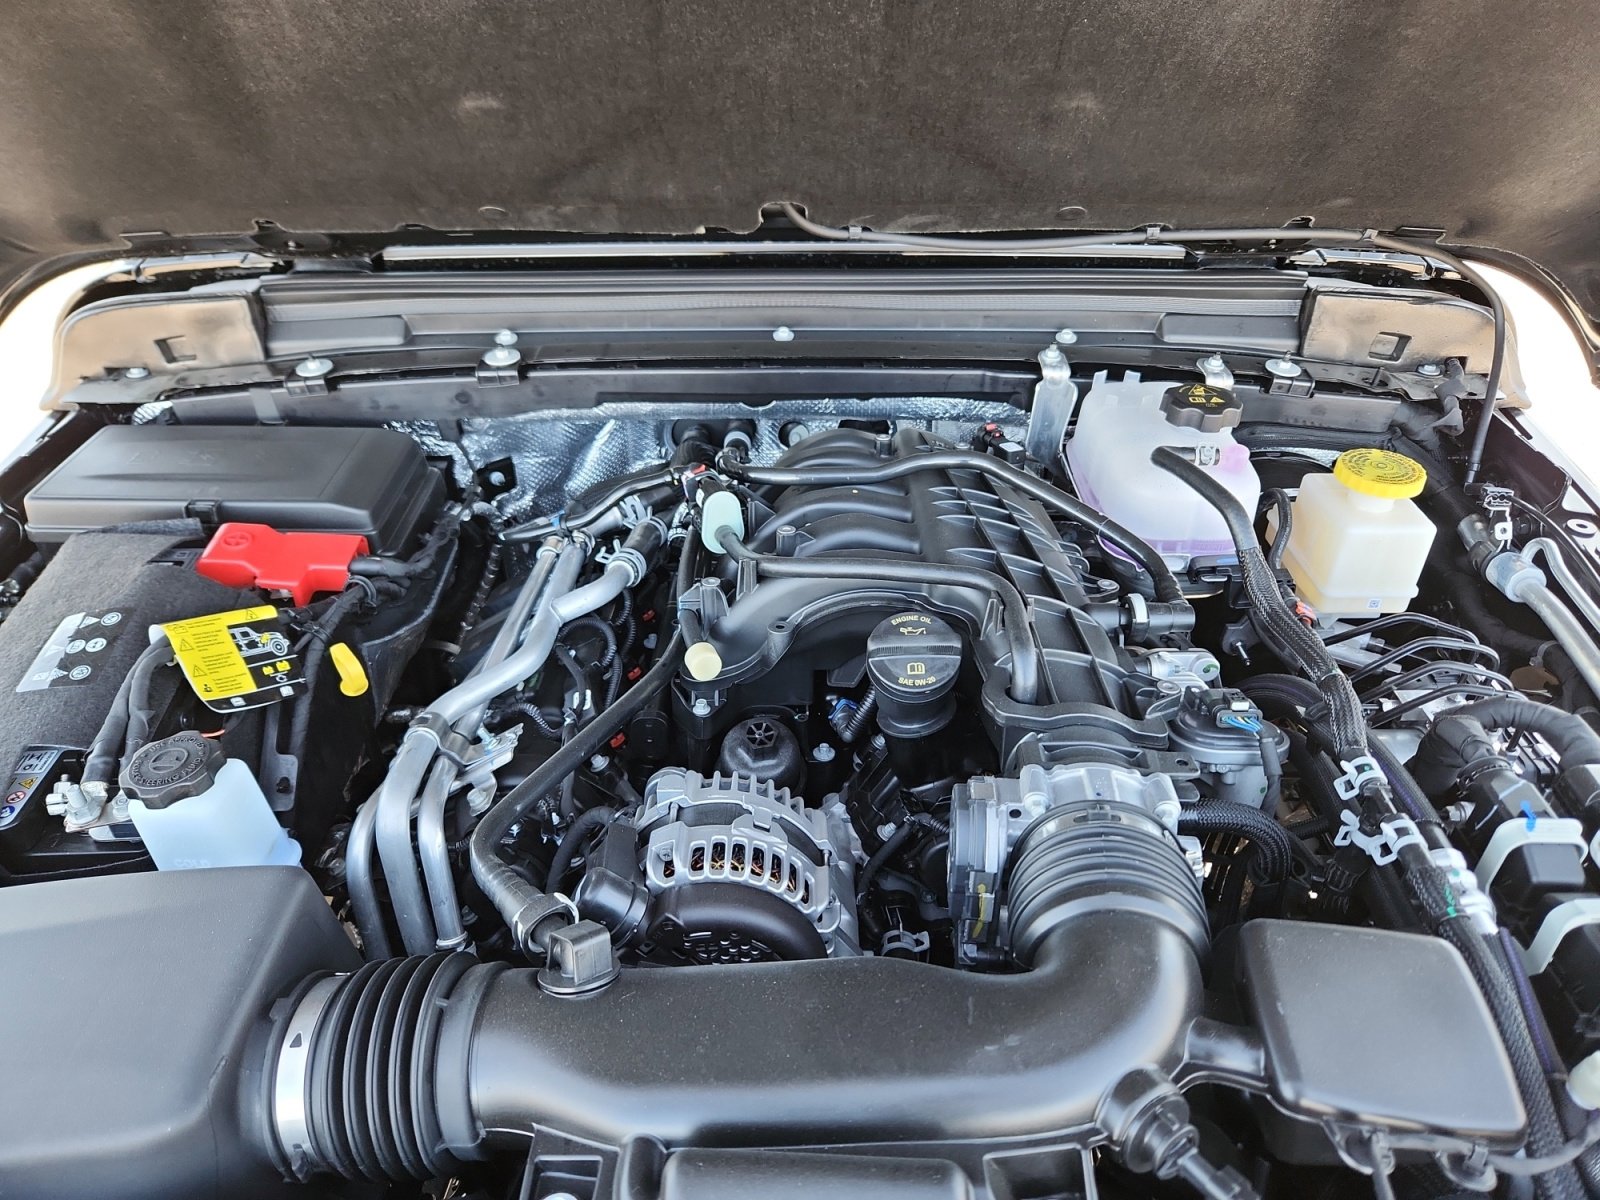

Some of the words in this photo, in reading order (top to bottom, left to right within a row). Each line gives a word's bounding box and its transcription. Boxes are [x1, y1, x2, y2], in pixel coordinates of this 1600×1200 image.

[891, 614, 919, 626] ENGINE
[920, 615, 932, 625] OIL
[898, 676, 914, 687] SAE
[914, 675, 936, 687] 0W-20
[139, 773, 180, 787] STEERING
